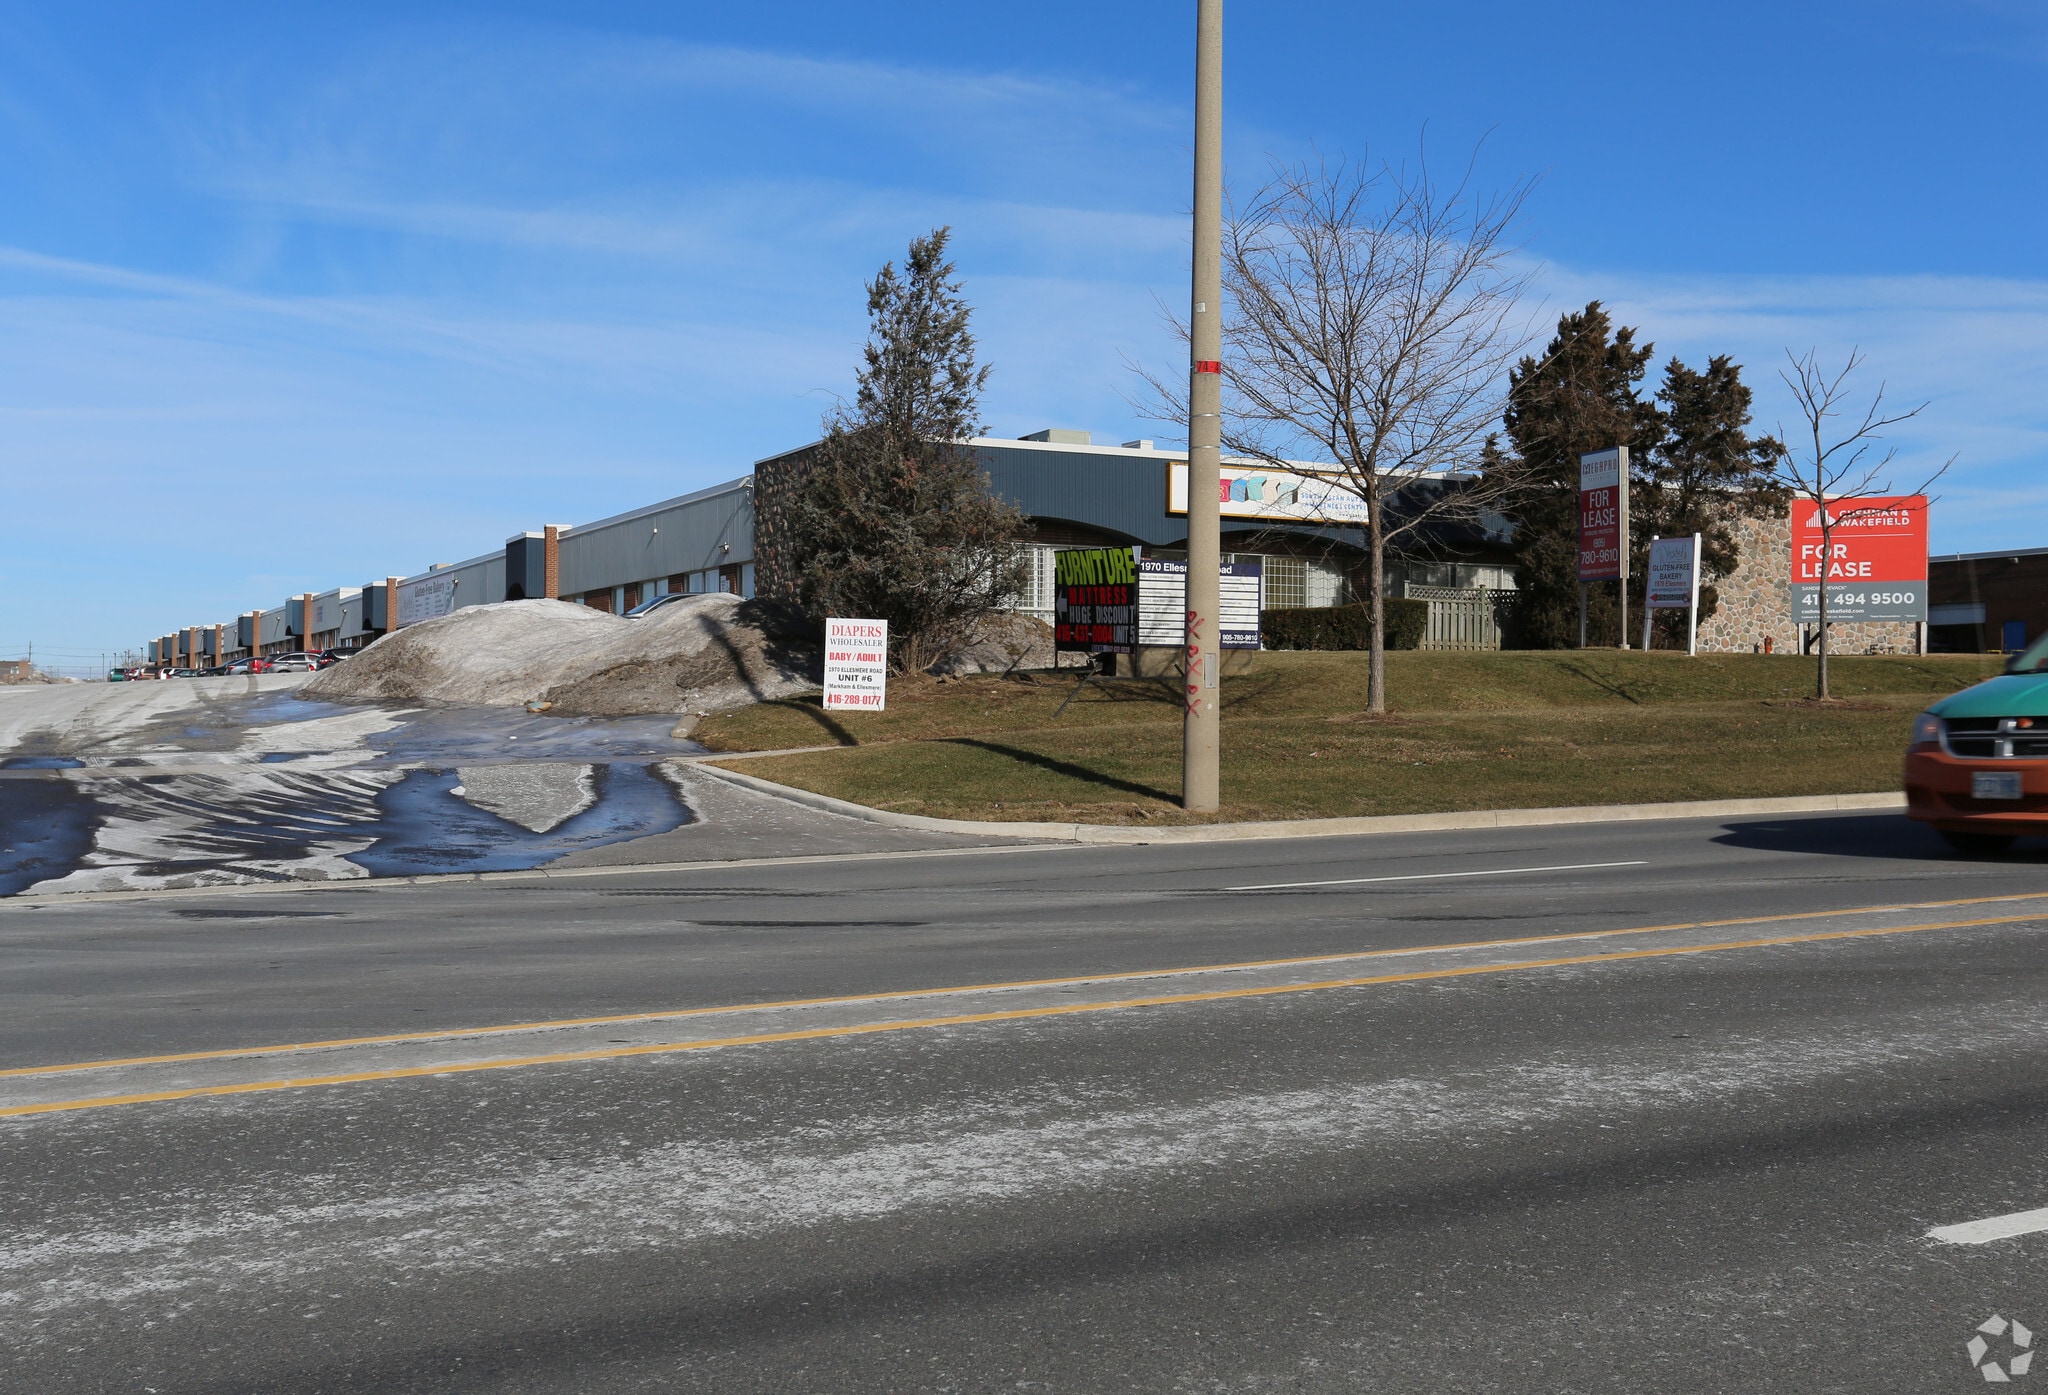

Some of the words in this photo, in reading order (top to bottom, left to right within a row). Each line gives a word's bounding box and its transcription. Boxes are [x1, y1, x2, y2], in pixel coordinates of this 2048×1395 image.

[1589, 489, 1609, 509] FOR
[1583, 507, 1616, 528] LEASE
[1901, 509, 1909, 517] &
[1840, 518, 1910, 527] WAKEFIELD
[1581, 548, 1618, 565] 780-9610
[1801, 544, 1848, 560] FOR
[1055, 547, 1136, 586] FURNITURE
[1140, 562, 1161, 571] 1970
[1652, 563, 1690, 572] GLUTEN-FREE
[1801, 561, 1872, 578] LEASE
[1660, 572, 1682, 580] BAKERY
[1068, 586, 1127, 605] MATTRESS
[1834, 593, 1866, 605] 494
[1870, 592, 1915, 605] 9500
[1069, 605, 1092, 624] HUGE
[831, 624, 882, 638] DIAPERS
[1113, 625, 1129, 644] UNIT
[829, 638, 883, 647] WHOLESALER
[838, 674, 859, 682] UNIT
